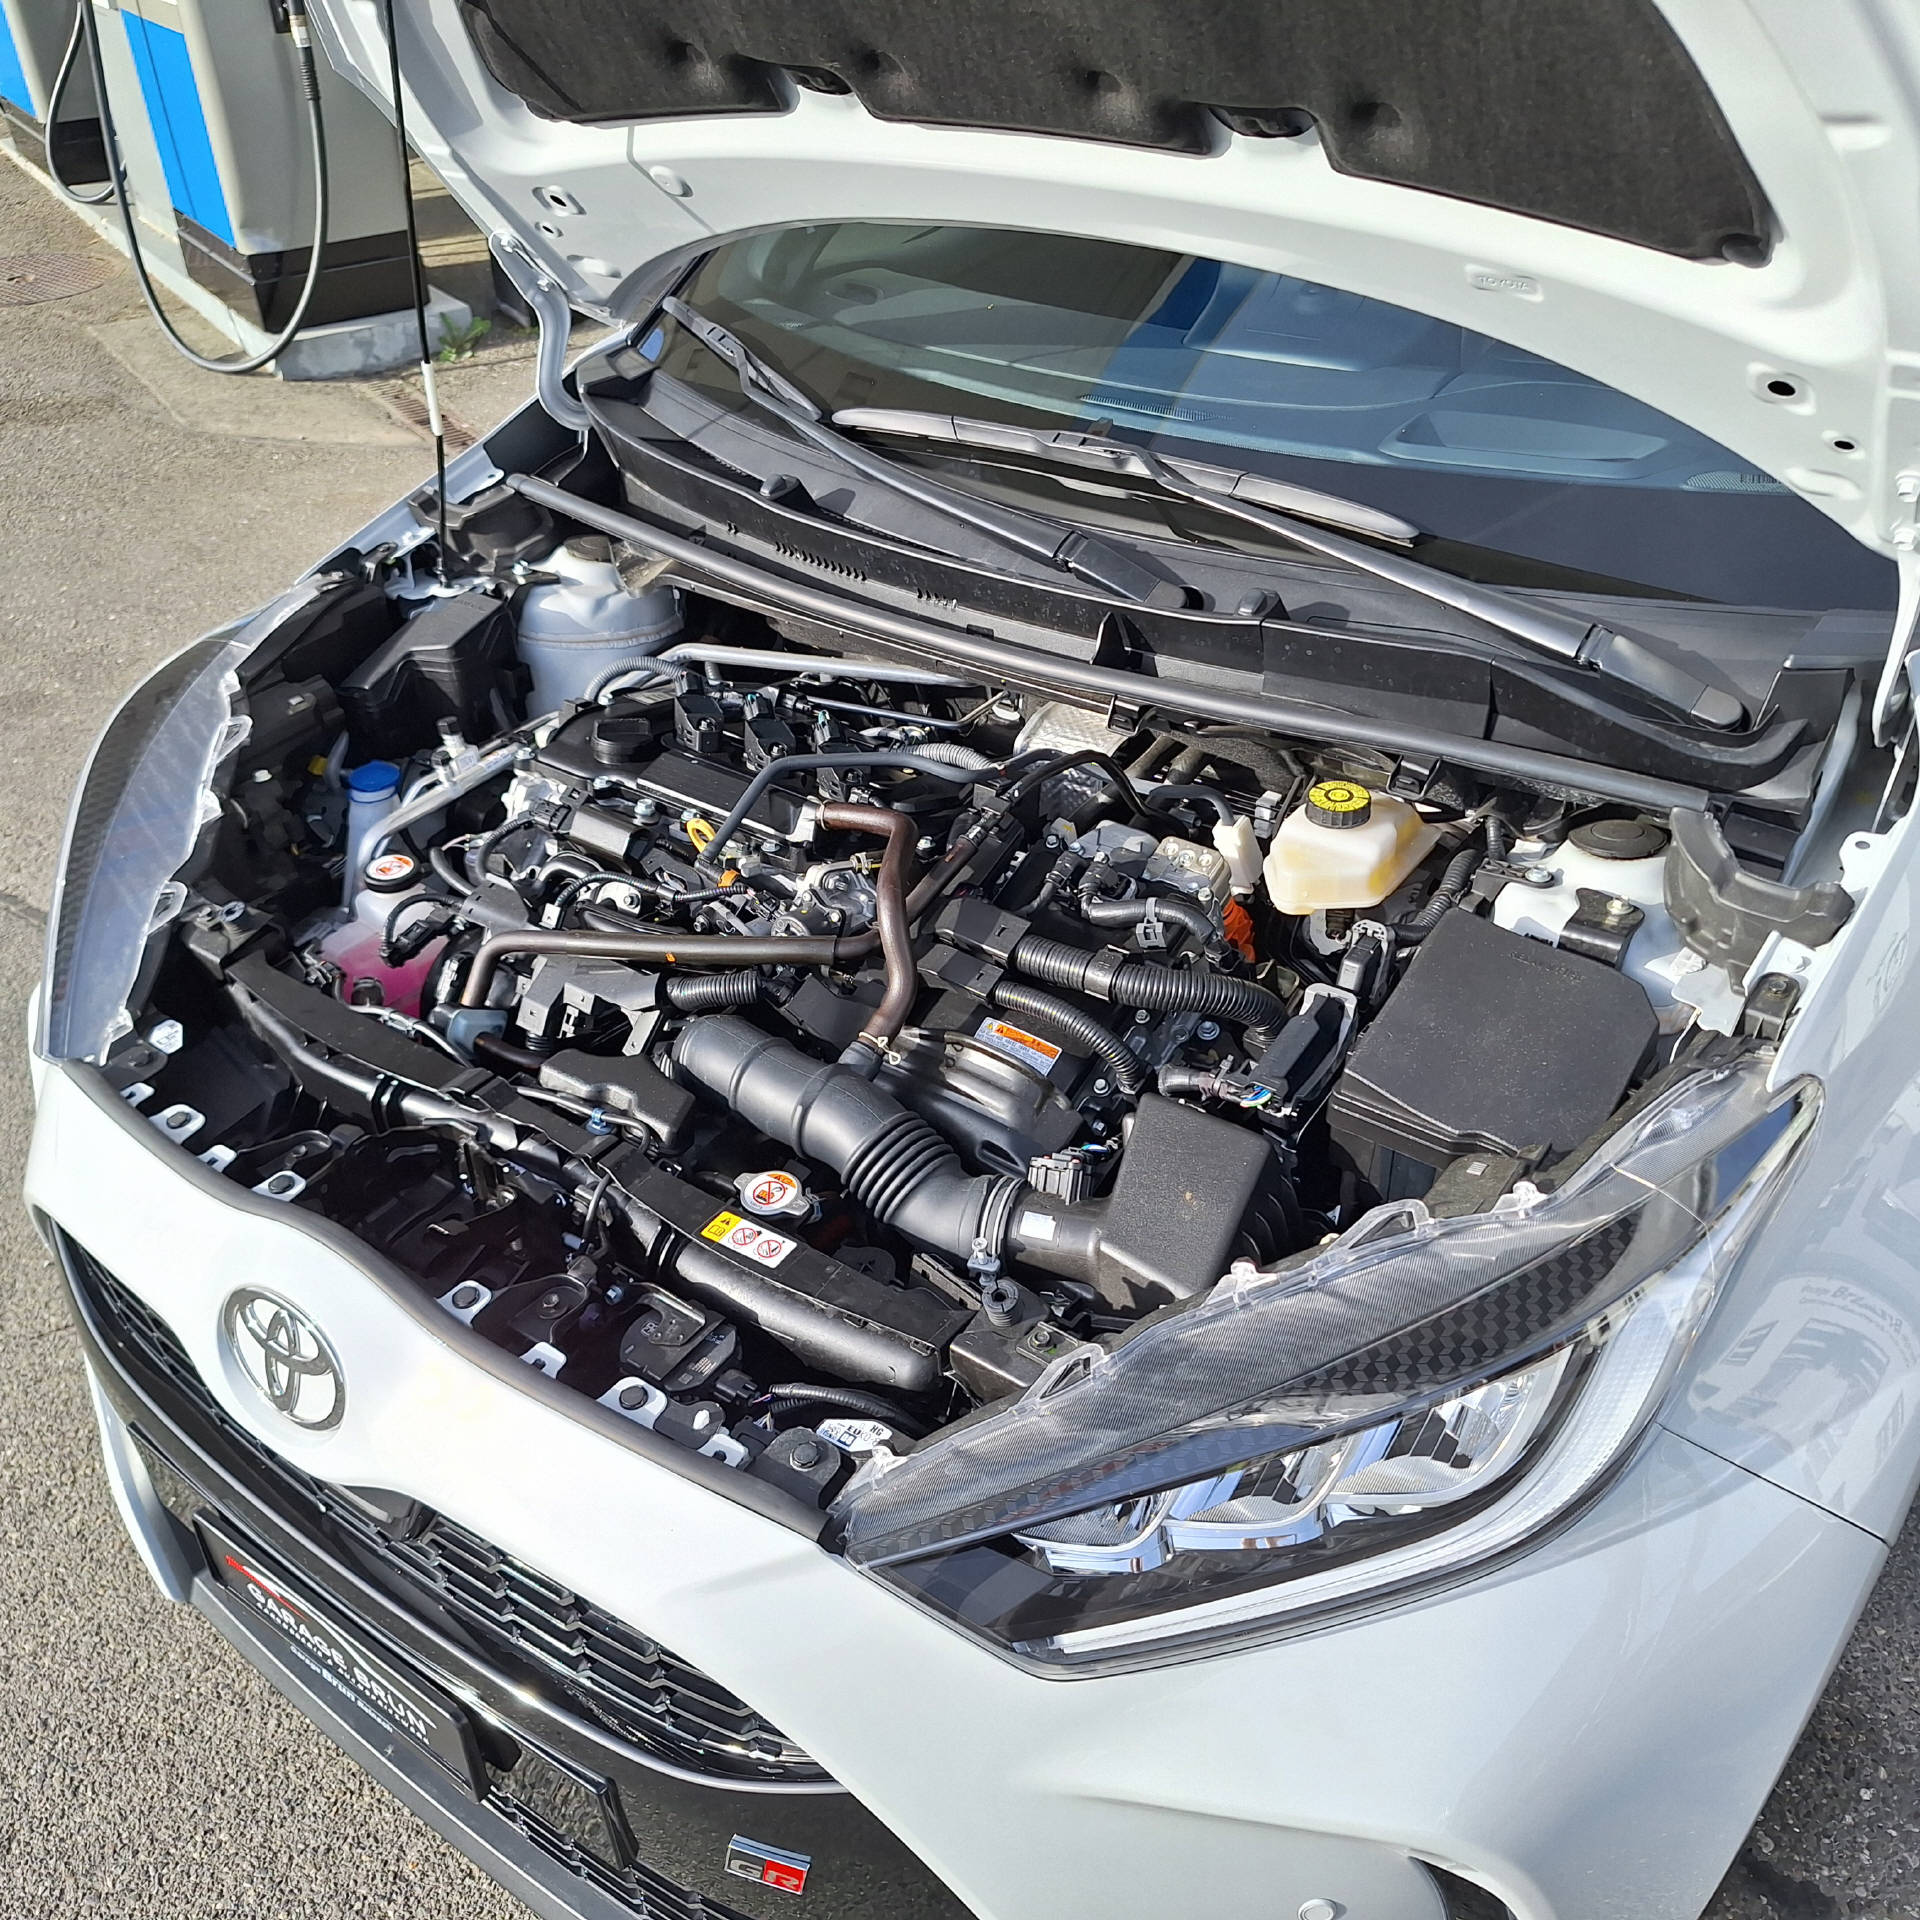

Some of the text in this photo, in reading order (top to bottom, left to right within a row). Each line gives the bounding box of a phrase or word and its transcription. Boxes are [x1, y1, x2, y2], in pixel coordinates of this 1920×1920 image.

[1479, 276, 1529, 290] TOYOTA
[248, 1583, 347, 1670] GARAGE
[353, 1666, 427, 1736] BRUN
[729, 1859, 800, 1891] GR
